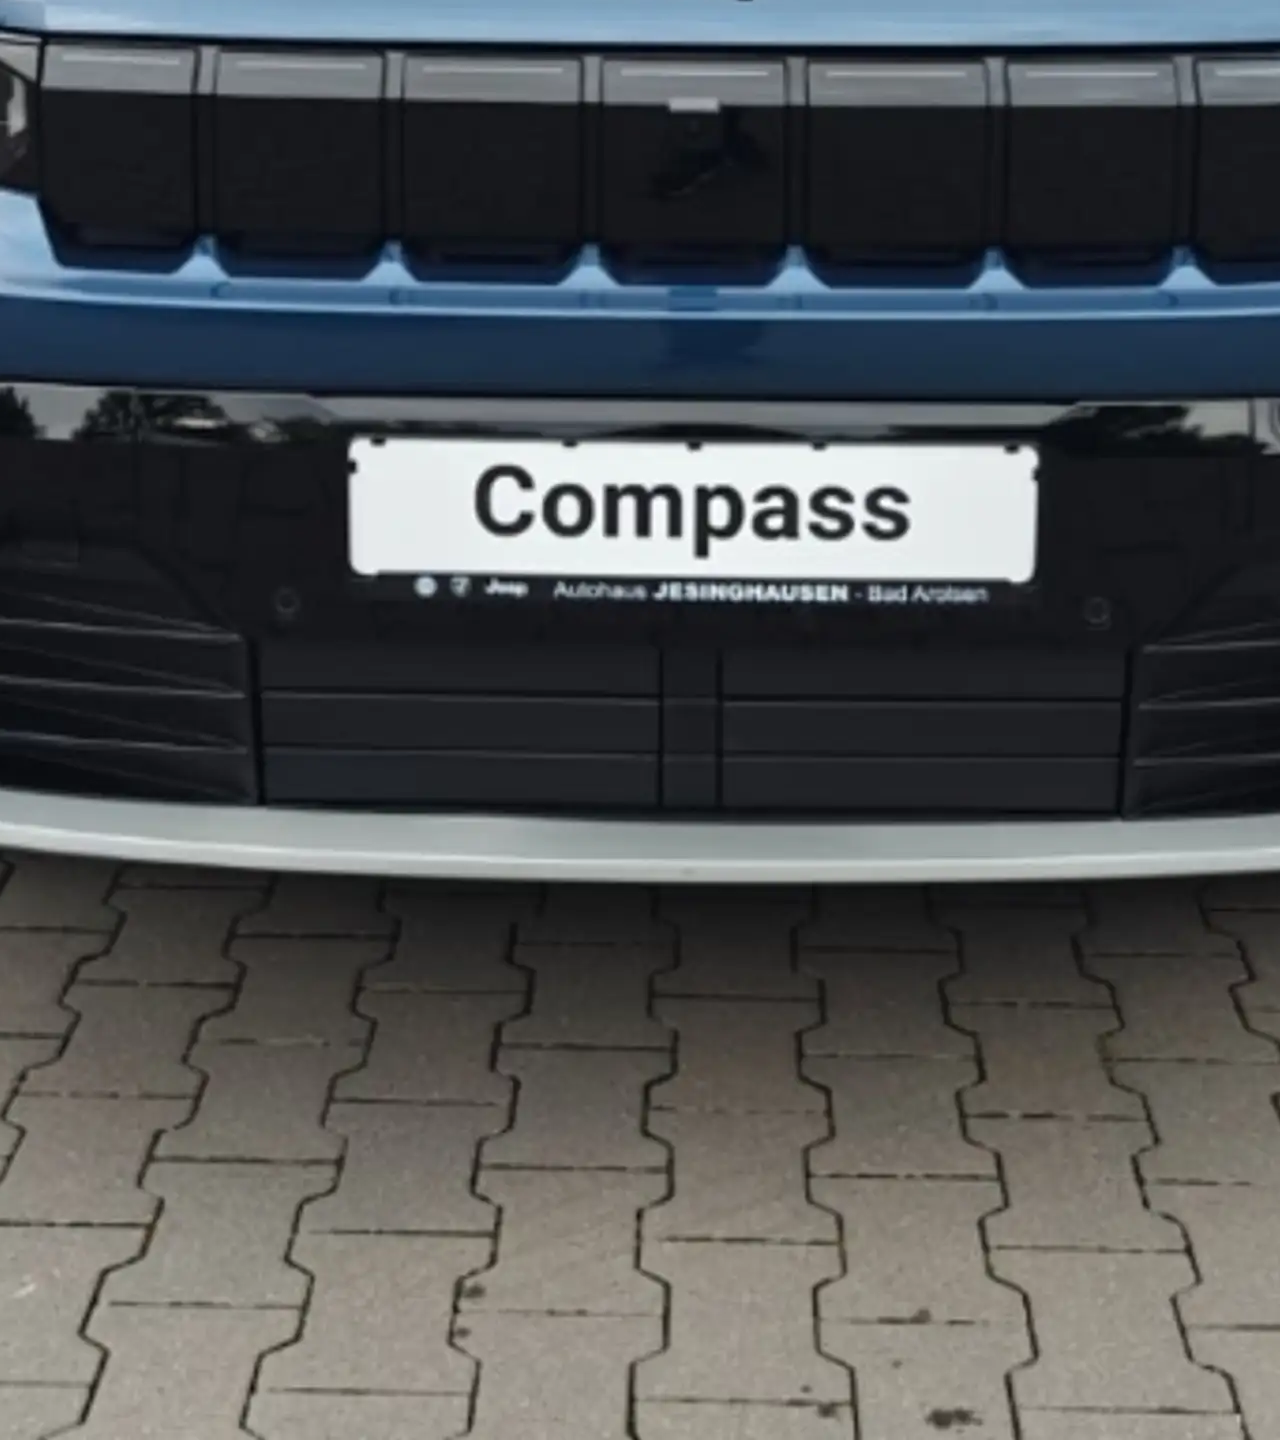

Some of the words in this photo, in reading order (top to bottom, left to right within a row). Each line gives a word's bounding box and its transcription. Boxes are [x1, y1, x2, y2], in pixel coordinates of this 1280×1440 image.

[474, 463, 911, 559] Compass
[552, 580, 647, 602] Autohaus
[653, 581, 849, 603] JESINGHAUSEN
[868, 584, 908, 602] Bad
